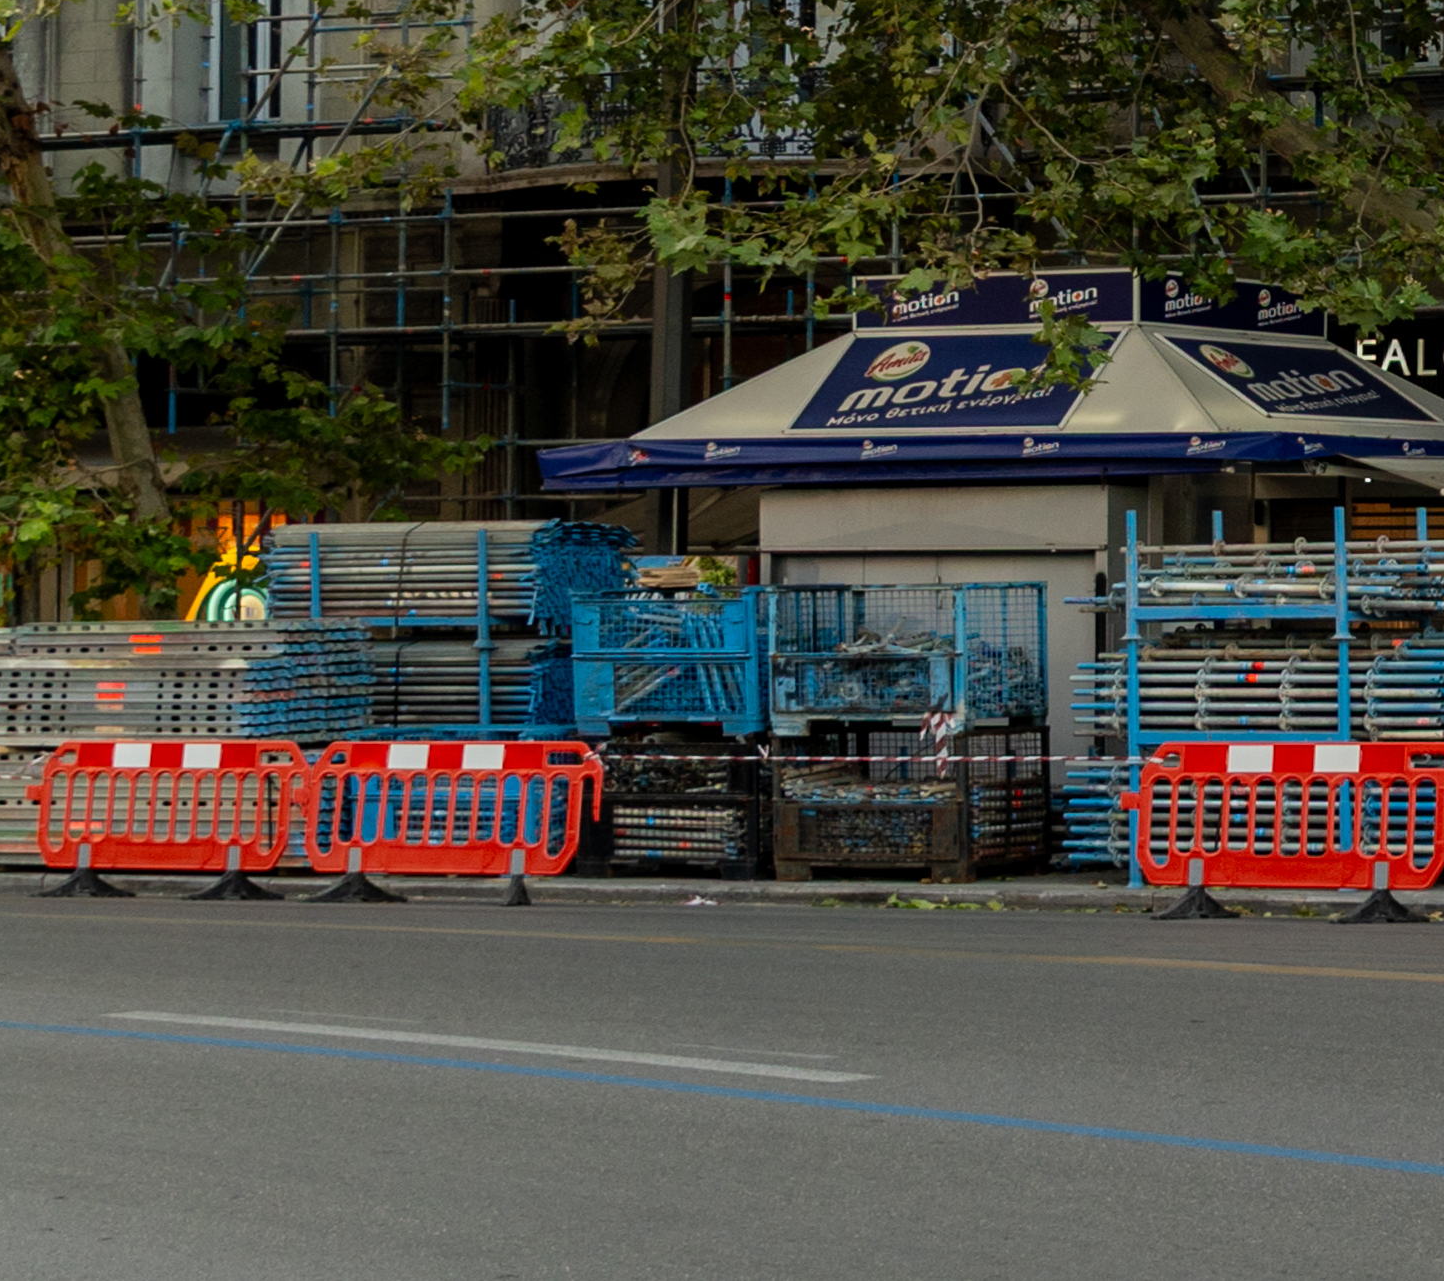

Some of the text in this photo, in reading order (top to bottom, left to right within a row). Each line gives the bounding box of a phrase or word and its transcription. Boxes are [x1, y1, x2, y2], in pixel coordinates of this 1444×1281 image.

[892, 290, 960, 315] motion
[1164, 293, 1212, 312] motio
[837, 363, 1047, 413] motio
[1246, 369, 1364, 402] motion
[825, 411, 880, 427] Μόνο
[885, 400, 953, 420] θετική
